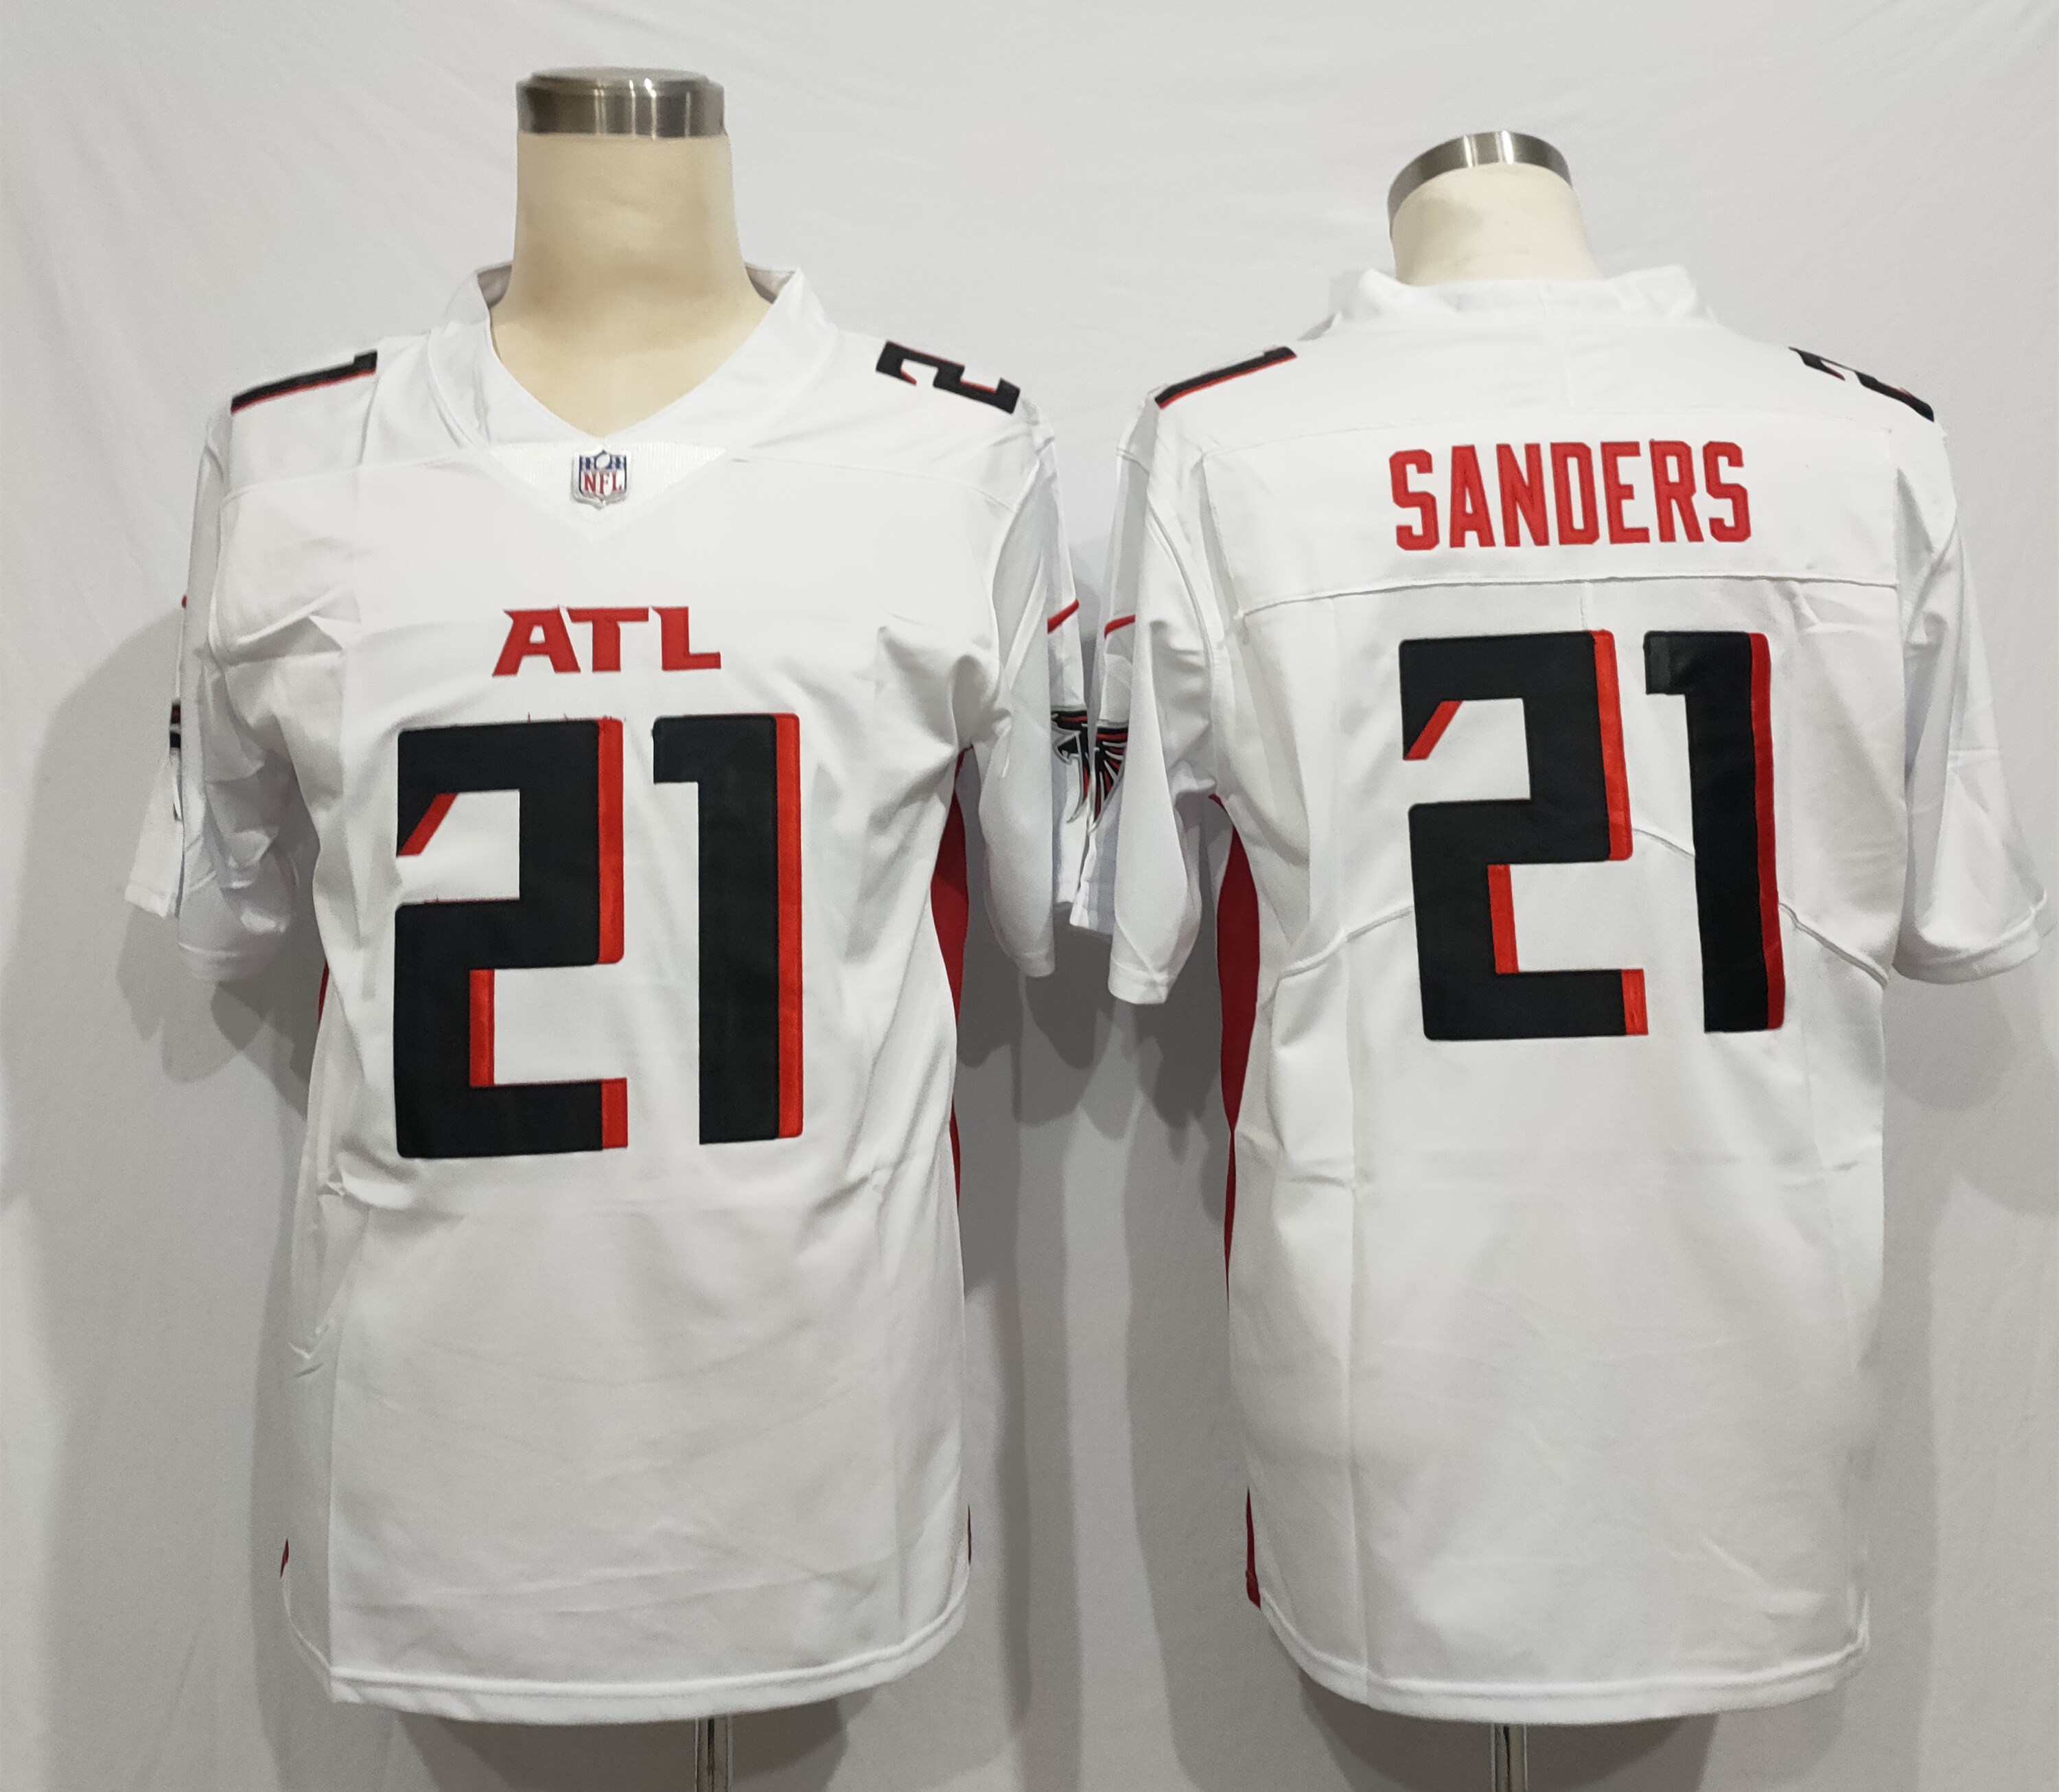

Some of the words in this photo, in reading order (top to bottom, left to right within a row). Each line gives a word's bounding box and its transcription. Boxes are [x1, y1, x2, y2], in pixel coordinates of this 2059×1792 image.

[583, 472, 623, 495] NFL
[1388, 439, 1752, 550] SANDERS
[493, 605, 721, 677] ATL
[1399, 629, 1785, 1040] 21
[394, 714, 802, 1160] 21
